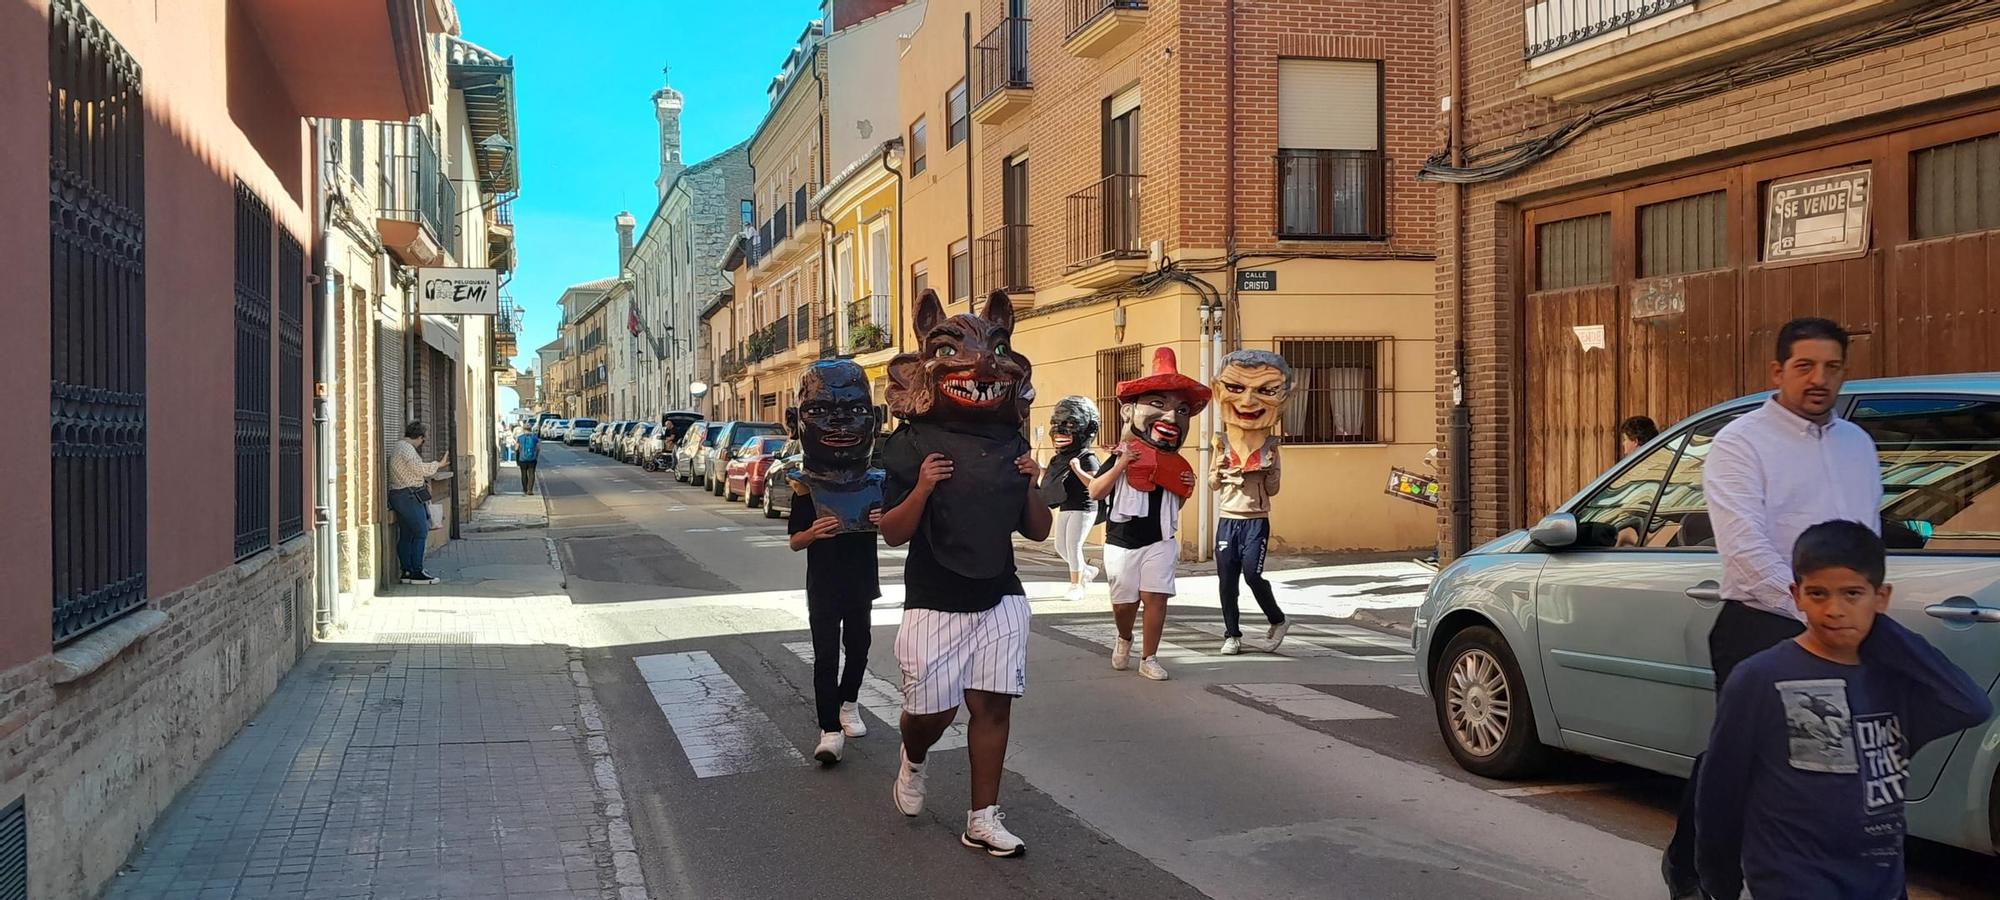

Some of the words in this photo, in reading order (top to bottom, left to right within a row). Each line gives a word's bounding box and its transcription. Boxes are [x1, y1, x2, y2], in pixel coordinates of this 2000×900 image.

[1784, 200, 1799, 219] SE
[1803, 192, 1846, 215] VENDE
[1243, 281, 1269, 290] CRISTO
[1864, 742, 1909, 778] THE
[1866, 768, 1910, 808] CIT
